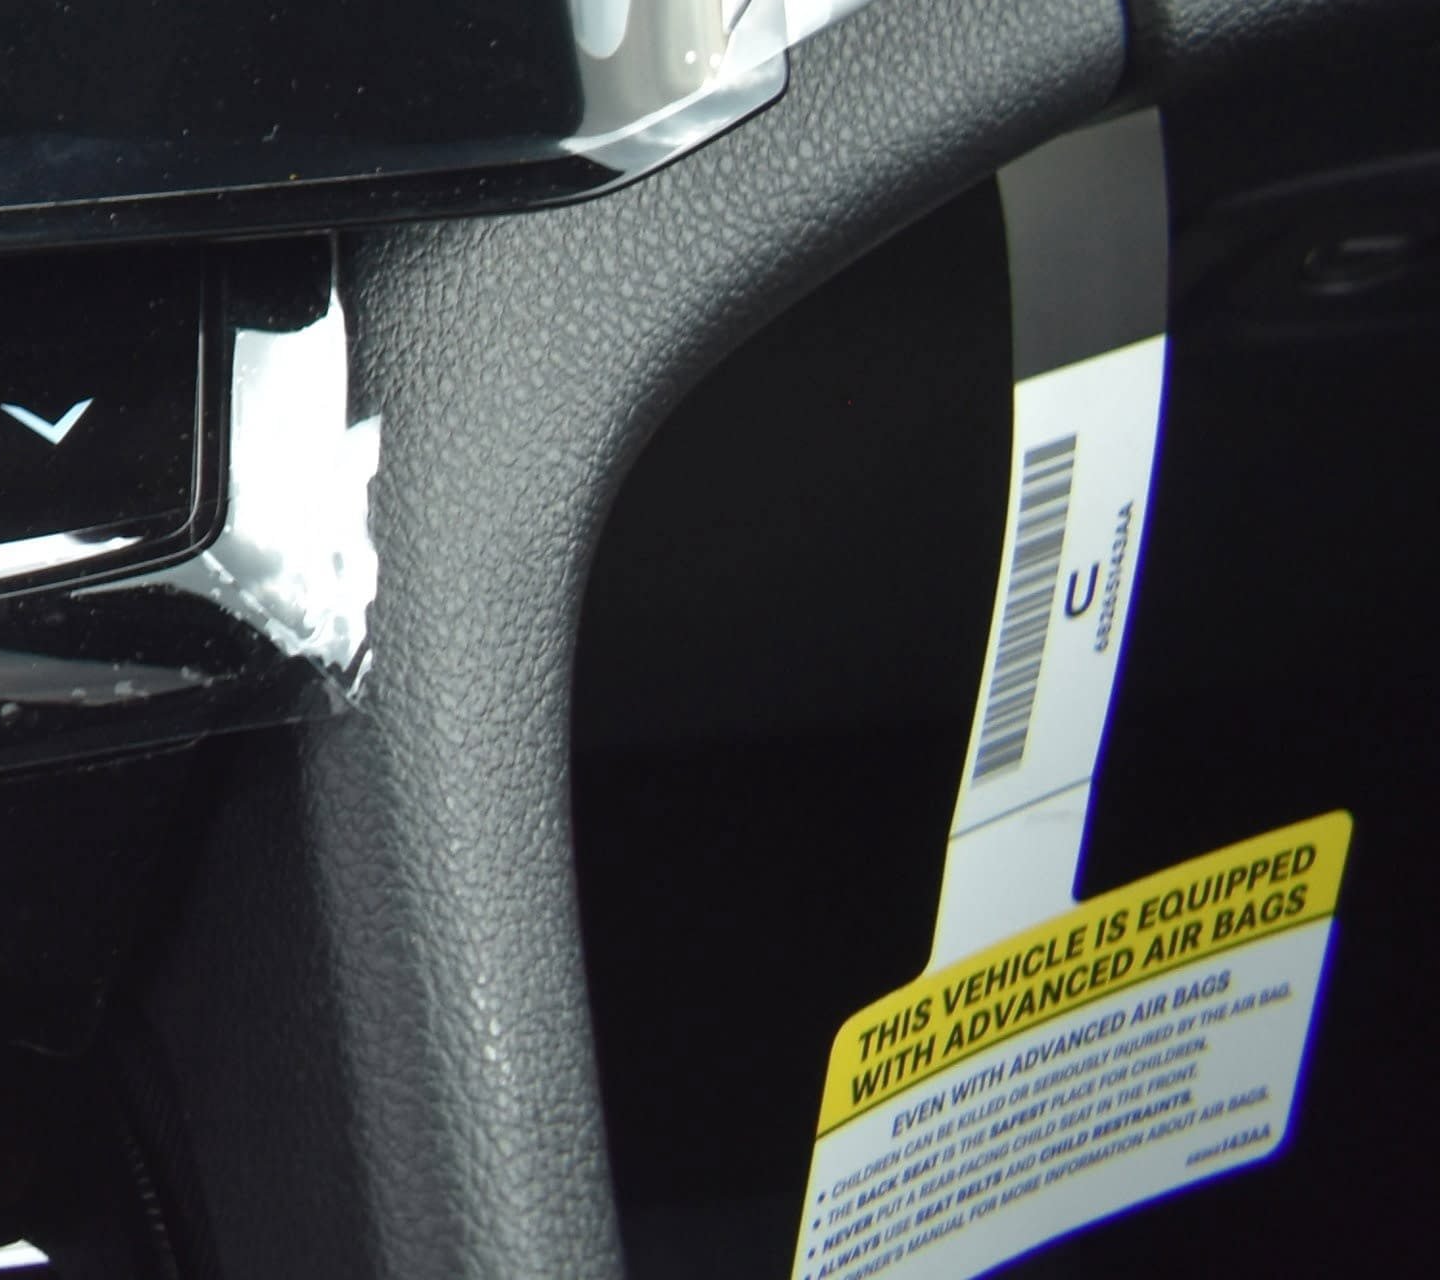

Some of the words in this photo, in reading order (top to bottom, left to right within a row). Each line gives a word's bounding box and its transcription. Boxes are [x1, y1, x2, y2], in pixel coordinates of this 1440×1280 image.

[1065, 561, 1100, 618] U
[851, 1034, 936, 1106] WITH
[941, 947, 1134, 1058] ADVANCED
[1142, 920, 1203, 968] AIR
[1211, 883, 1308, 942] BAGS
[859, 998, 933, 1064] THIS
[943, 924, 1088, 1017] VEHICLE
[1094, 910, 1129, 949] IS
[1136, 843, 1317, 932] EQUIPPED
[831, 1148, 902, 1199] CHILDREN
[903, 1131, 934, 1160] CAN
[937, 1120, 955, 1142] BE
[957, 1095, 1007, 1132] KILLED
[1009, 1083, 1029, 1105] OR
[1033, 1049, 1110, 1094] SERIOUSLY
[1113, 1023, 1174, 1061] INJURED
[1177, 1015, 1196, 1036] BY
[1200, 1001, 1229, 1025] THE
[1230, 992, 1256, 1016] AIR
[892, 1091, 946, 1137] EVEN
[951, 1060, 1005, 1106] WITH
[1009, 1010, 1126, 1079] ADVANCED
[1131, 993, 1167, 1026] AIR
[1173, 969, 1232, 1009] BAGS
[818, 1233, 880, 1280] ALWAYS
[915, 1195, 953, 1226] SEAT
[956, 1169, 1003, 1204] BELTS
[1004, 1153, 1036, 1180] AND
[1039, 1131, 1089, 1163] CHILD
[823, 1214, 874, 1254] NEVER
[877, 1195, 903, 1222] PUT
[906, 1191, 916, 1208] A
[1012, 1121, 1056, 1152] CHILD
[1059, 1103, 1094, 1130] SEAT
[1117, 1082, 1144, 1107] THE
[828, 1199, 854, 1225] THE
[857, 1175, 898, 1209] BACK
[902, 1151, 939, 1184] SEAT
[960, 1127, 987, 1153] THE
[990, 1098, 1049, 1139] SAFEST
[1050, 1078, 1095, 1111] PLACE
[1098, 1065, 1128, 1090] FOR
[906, 1212, 965, 1254] MANUAL
[1000, 1173, 1042, 1207] MORE
[1044, 1131, 1145, 1186] INFORMATION
[1146, 1109, 1197, 1142] ABOUT
[1199, 1100, 1225, 1123] AIR
